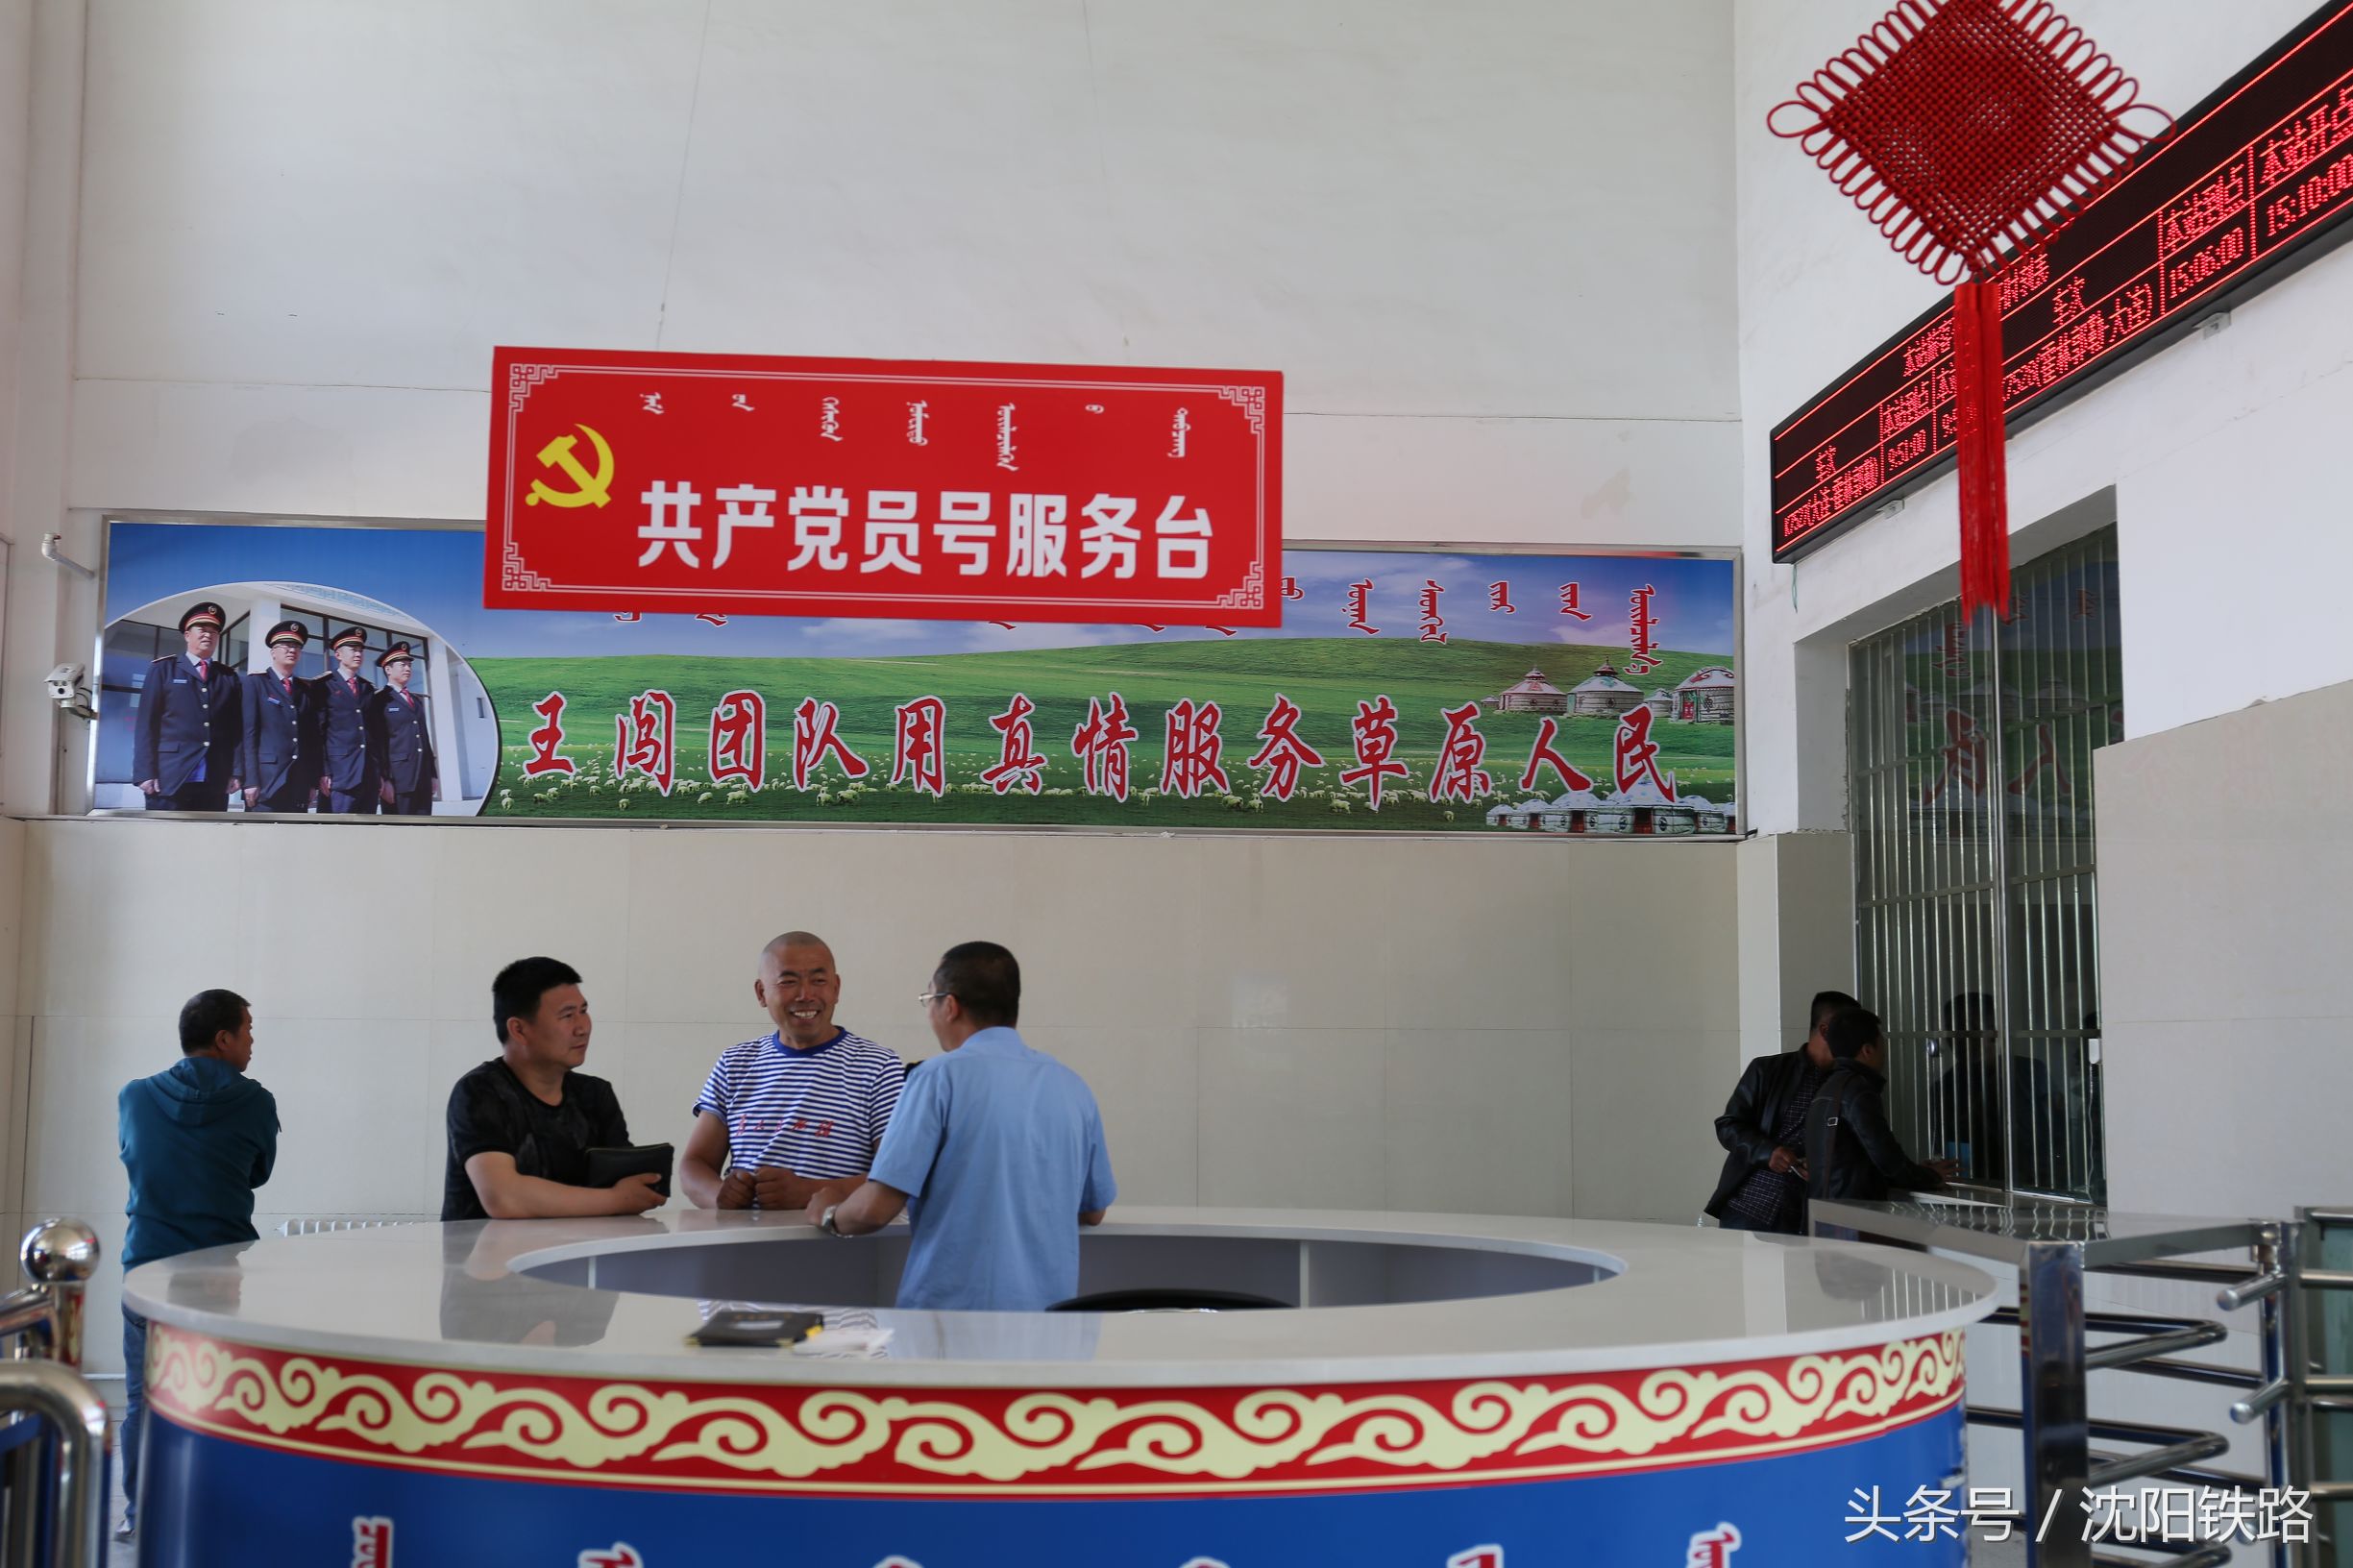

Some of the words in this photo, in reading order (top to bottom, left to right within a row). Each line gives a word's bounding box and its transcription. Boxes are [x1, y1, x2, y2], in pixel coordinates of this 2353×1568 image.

[2164, 164, 2246, 253] 本站到点
[637, 480, 1213, 579] 共产党员号服务台
[523, 688, 1677, 813] 王闯团队用真情服务草原人民
